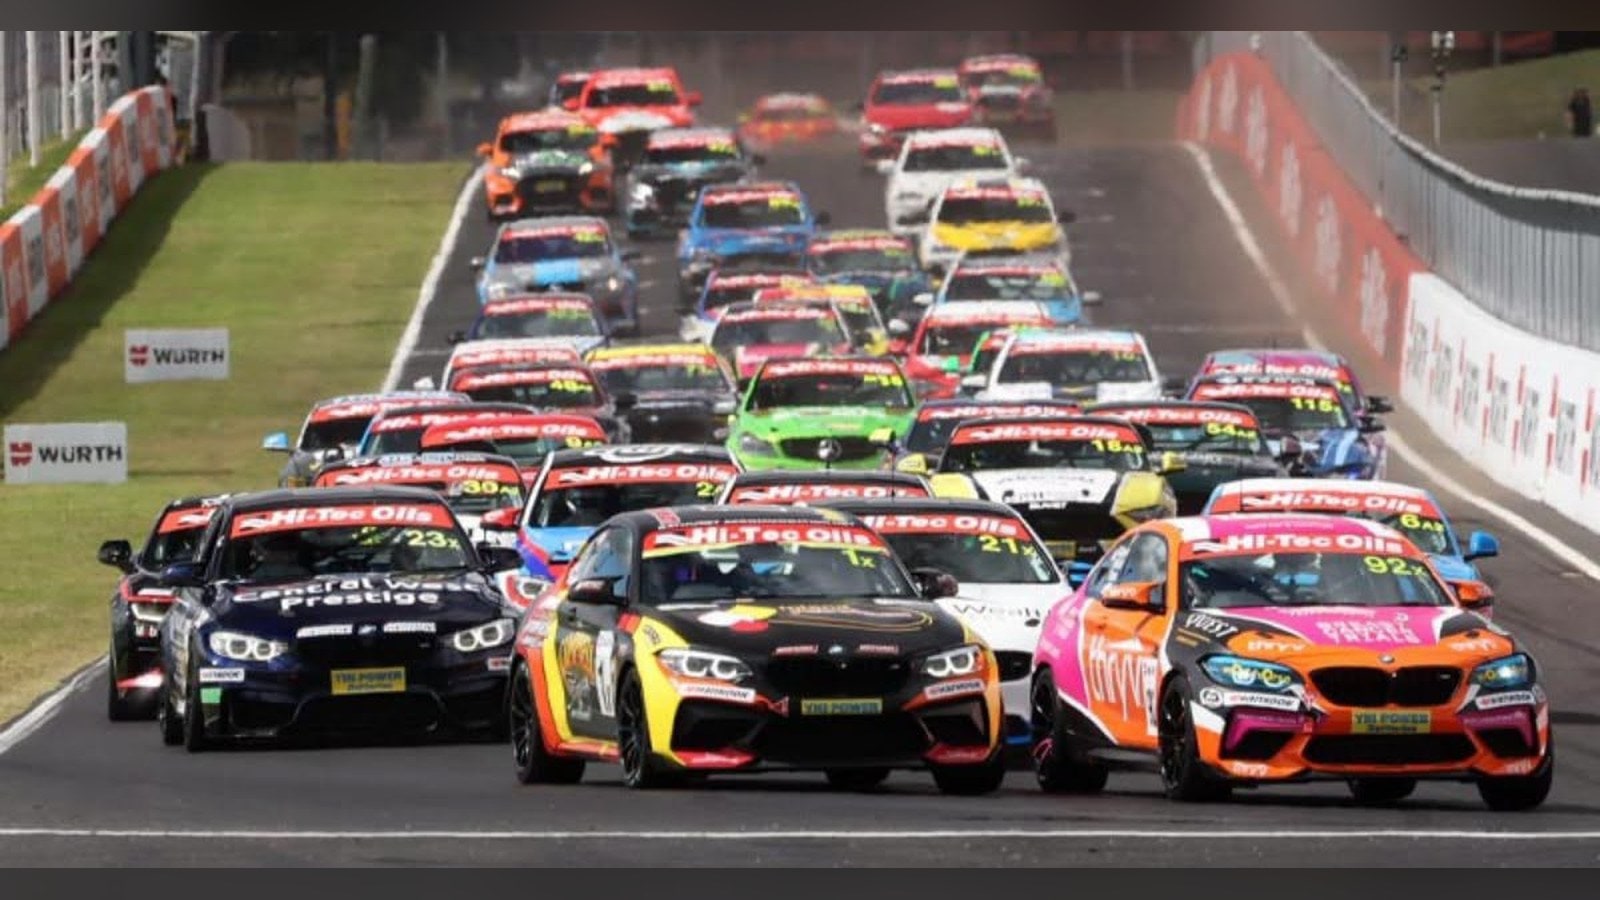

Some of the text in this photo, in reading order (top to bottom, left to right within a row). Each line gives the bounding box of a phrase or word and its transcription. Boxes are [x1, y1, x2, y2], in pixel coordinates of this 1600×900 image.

[989, 425, 1120, 440] Hi-Tec Oils
[364, 465, 500, 484] Hi-Tec Oils
[588, 464, 735, 481] Hi-Tec Oils
[1271, 491, 1423, 515] Hi-Tec Oils
[271, 505, 434, 528] Hi-Tec Oils
[863, 513, 1018, 536] Hi-Tec Oils
[692, 525, 872, 546] Hi-Tec Oils
[1226, 533, 1404, 554] Hi-Tec Oils
